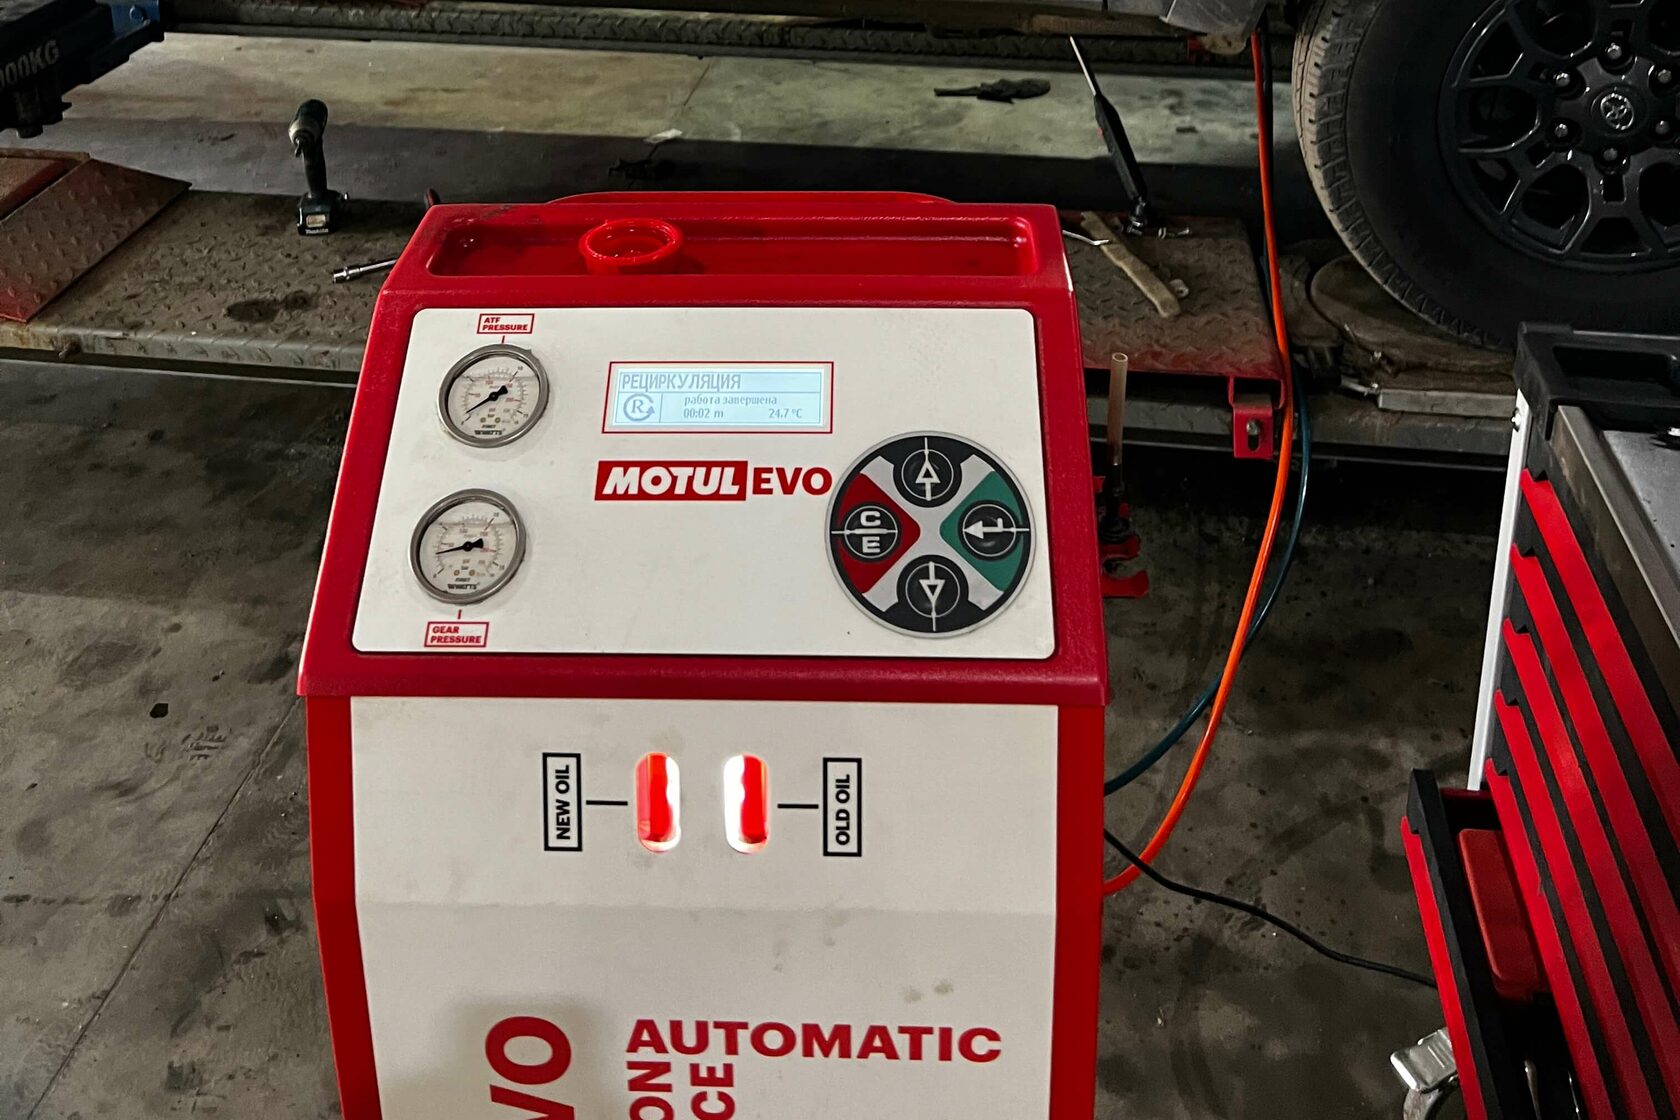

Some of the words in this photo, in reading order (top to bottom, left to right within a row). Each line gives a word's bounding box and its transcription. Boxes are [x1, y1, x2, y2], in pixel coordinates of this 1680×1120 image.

[621, 373, 742, 392] РЕЦИРКУЛЯЦИЯ
[683, 408, 710, 419] 00:02
[768, 408, 789, 419] 24.7
[684, 395, 721, 407] работа
[722, 396, 778, 407] завершена
[601, 466, 741, 496] MOTUL
[752, 466, 833, 496] EVO
[430, 635, 482, 643] PRESSURE
[432, 625, 460, 633] GEAR
[555, 764, 570, 794] OIL
[835, 774, 850, 804] OIL
[556, 798, 571, 840] NEW
[835, 809, 850, 846] OLD
[625, 1018, 1002, 1063] AUTOMATIC
